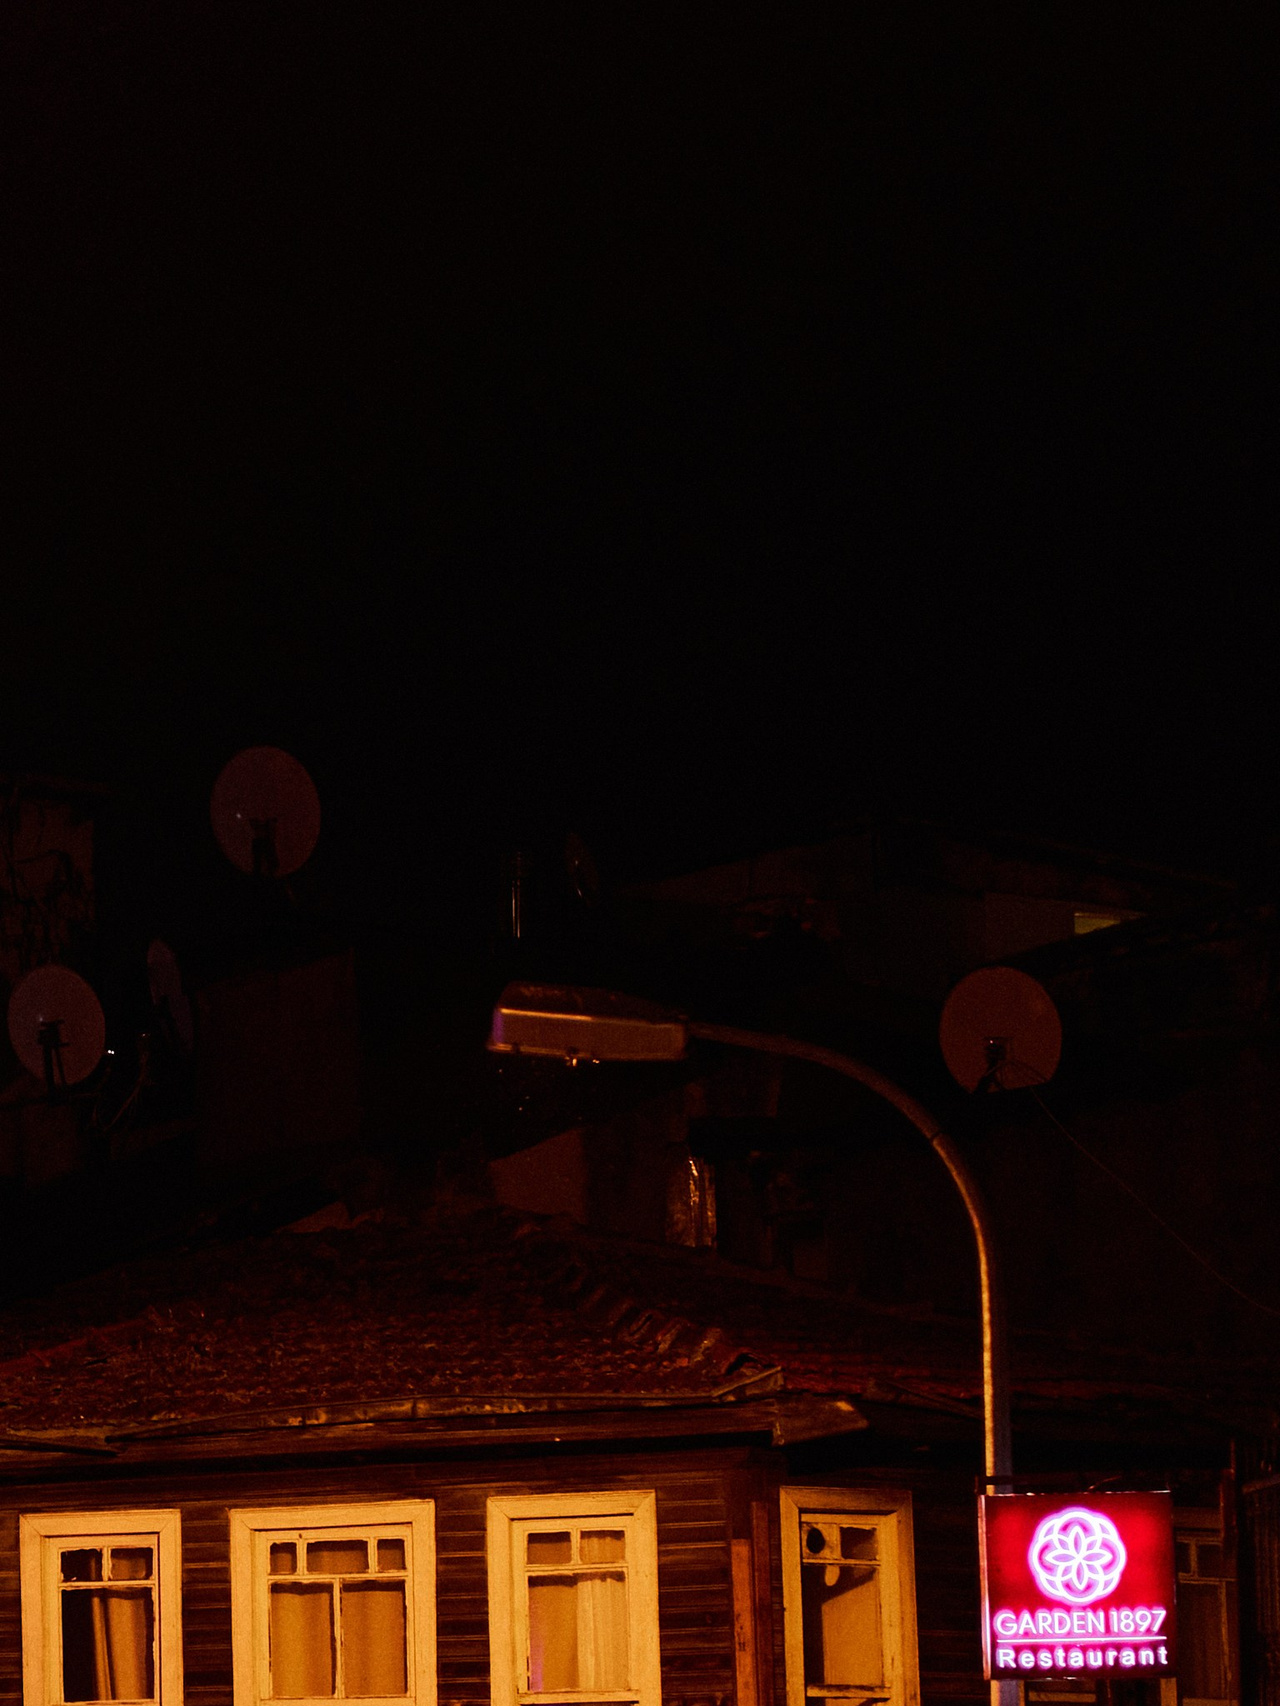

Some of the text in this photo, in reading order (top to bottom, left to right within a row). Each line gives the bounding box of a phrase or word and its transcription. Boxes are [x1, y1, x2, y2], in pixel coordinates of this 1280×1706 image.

[995, 1608, 1167, 1636] GARDEN 1897
[997, 1645, 1169, 1668] Restaurant
